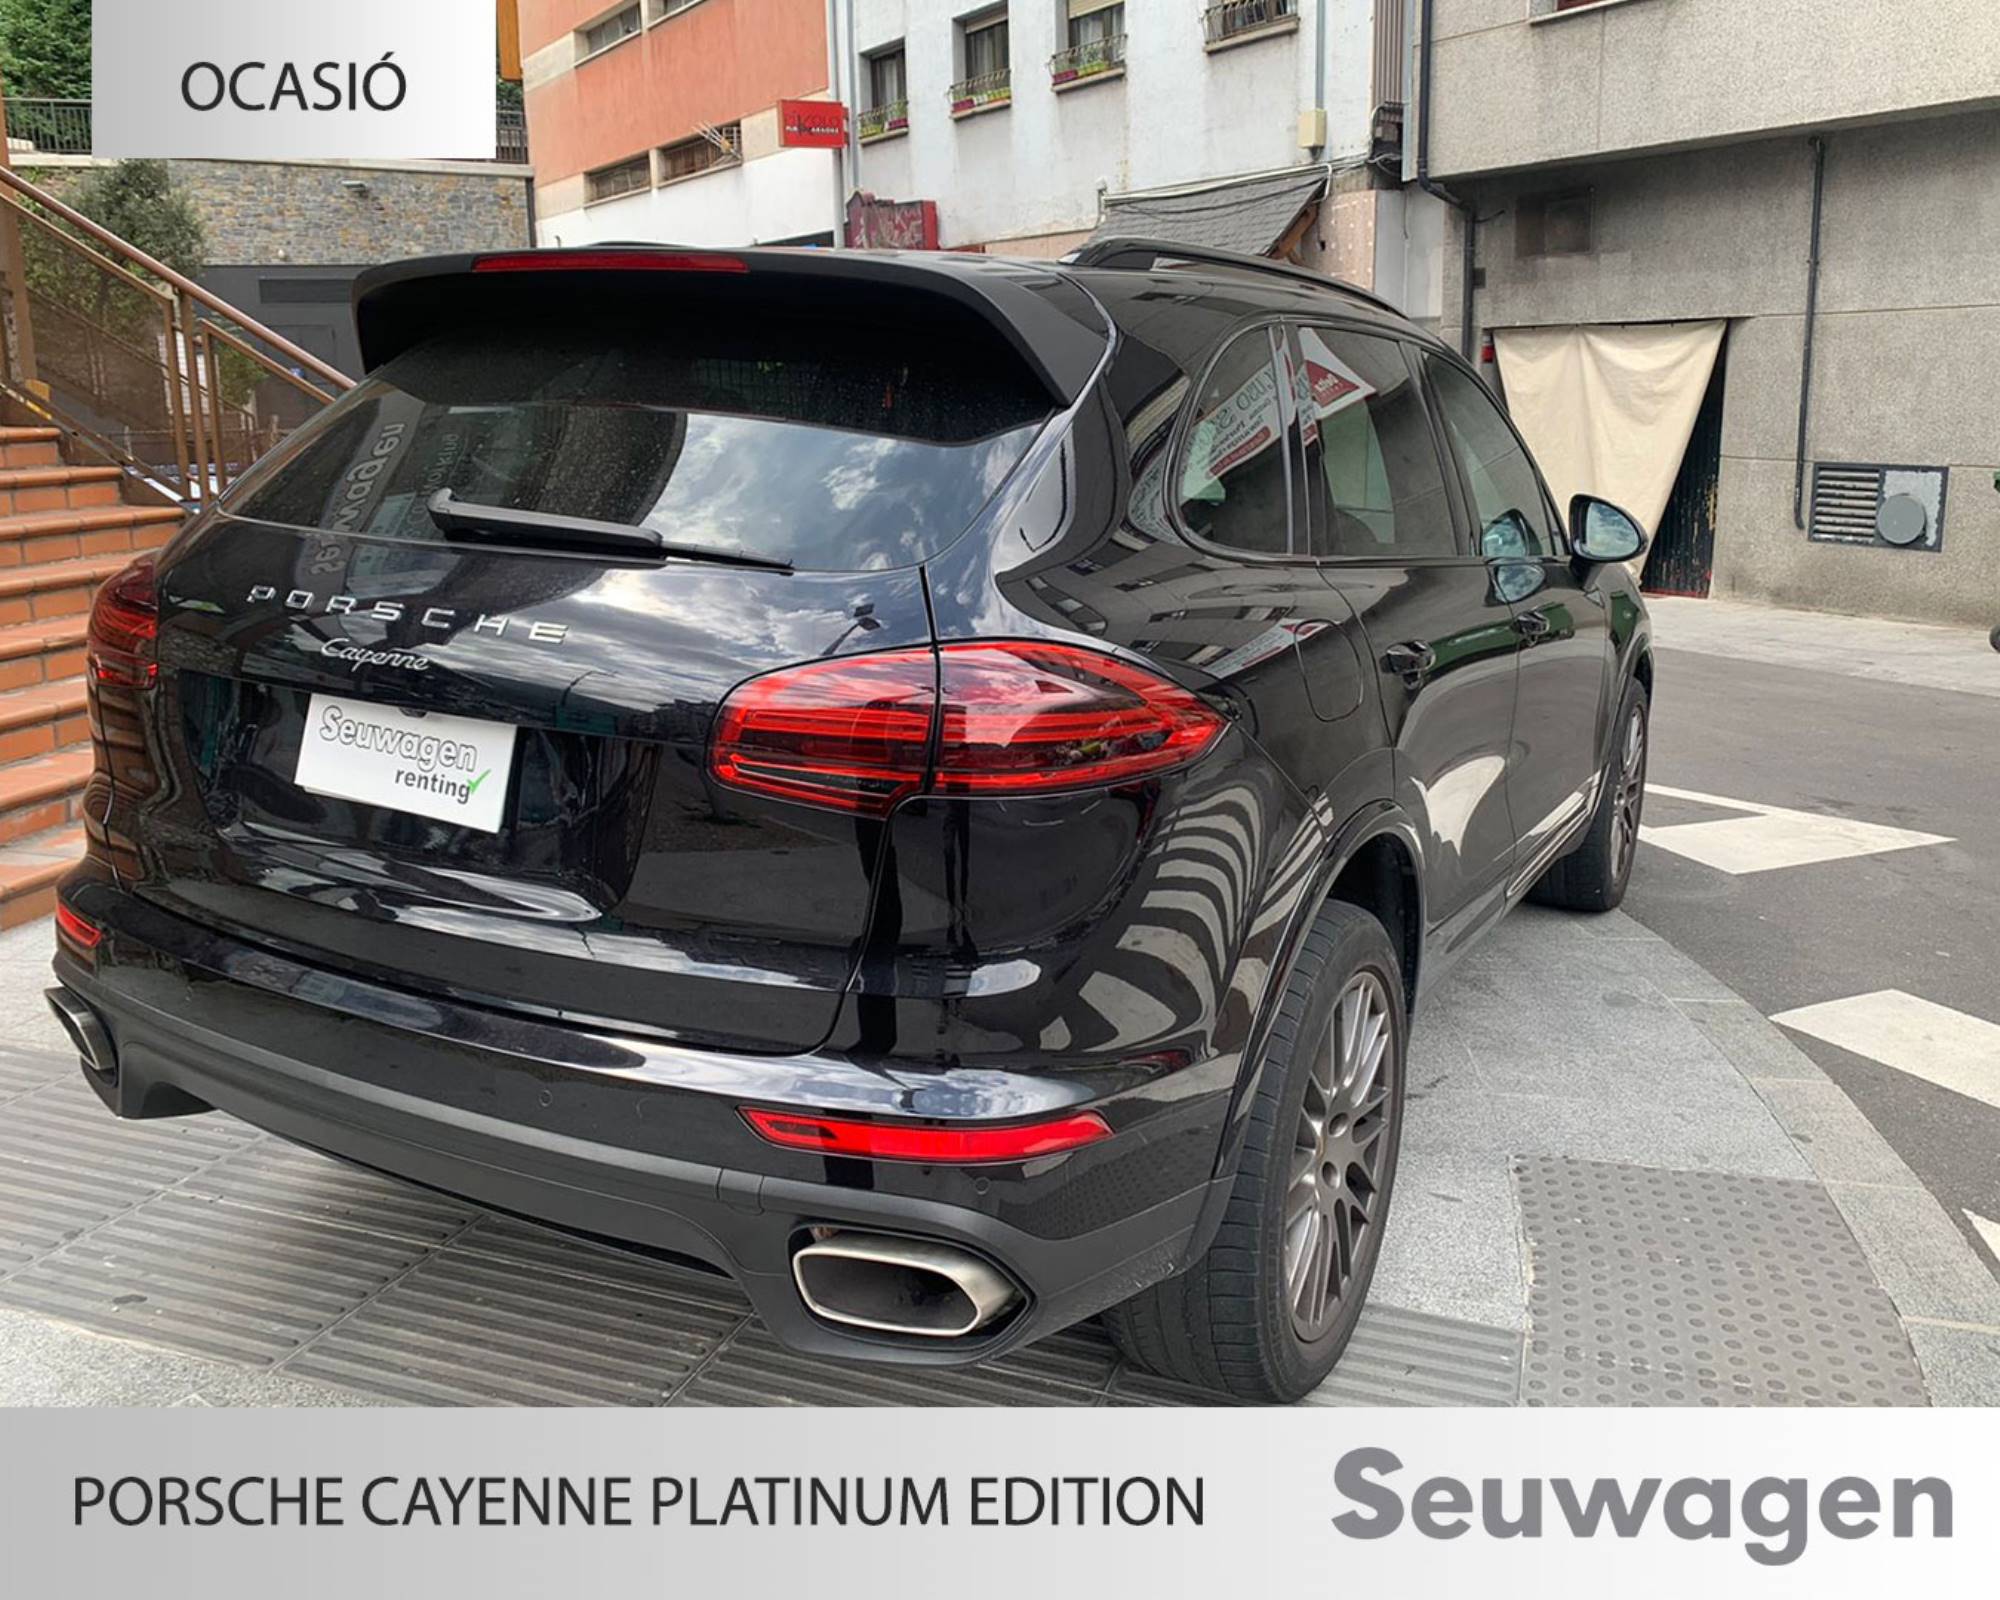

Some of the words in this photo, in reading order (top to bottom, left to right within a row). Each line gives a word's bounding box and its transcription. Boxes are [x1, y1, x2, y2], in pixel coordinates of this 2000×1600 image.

[247, 584, 569, 645] PORSCHE
[320, 637, 432, 672] Cayenne
[319, 704, 478, 772] Seuwagen
[395, 769, 472, 805] renting
